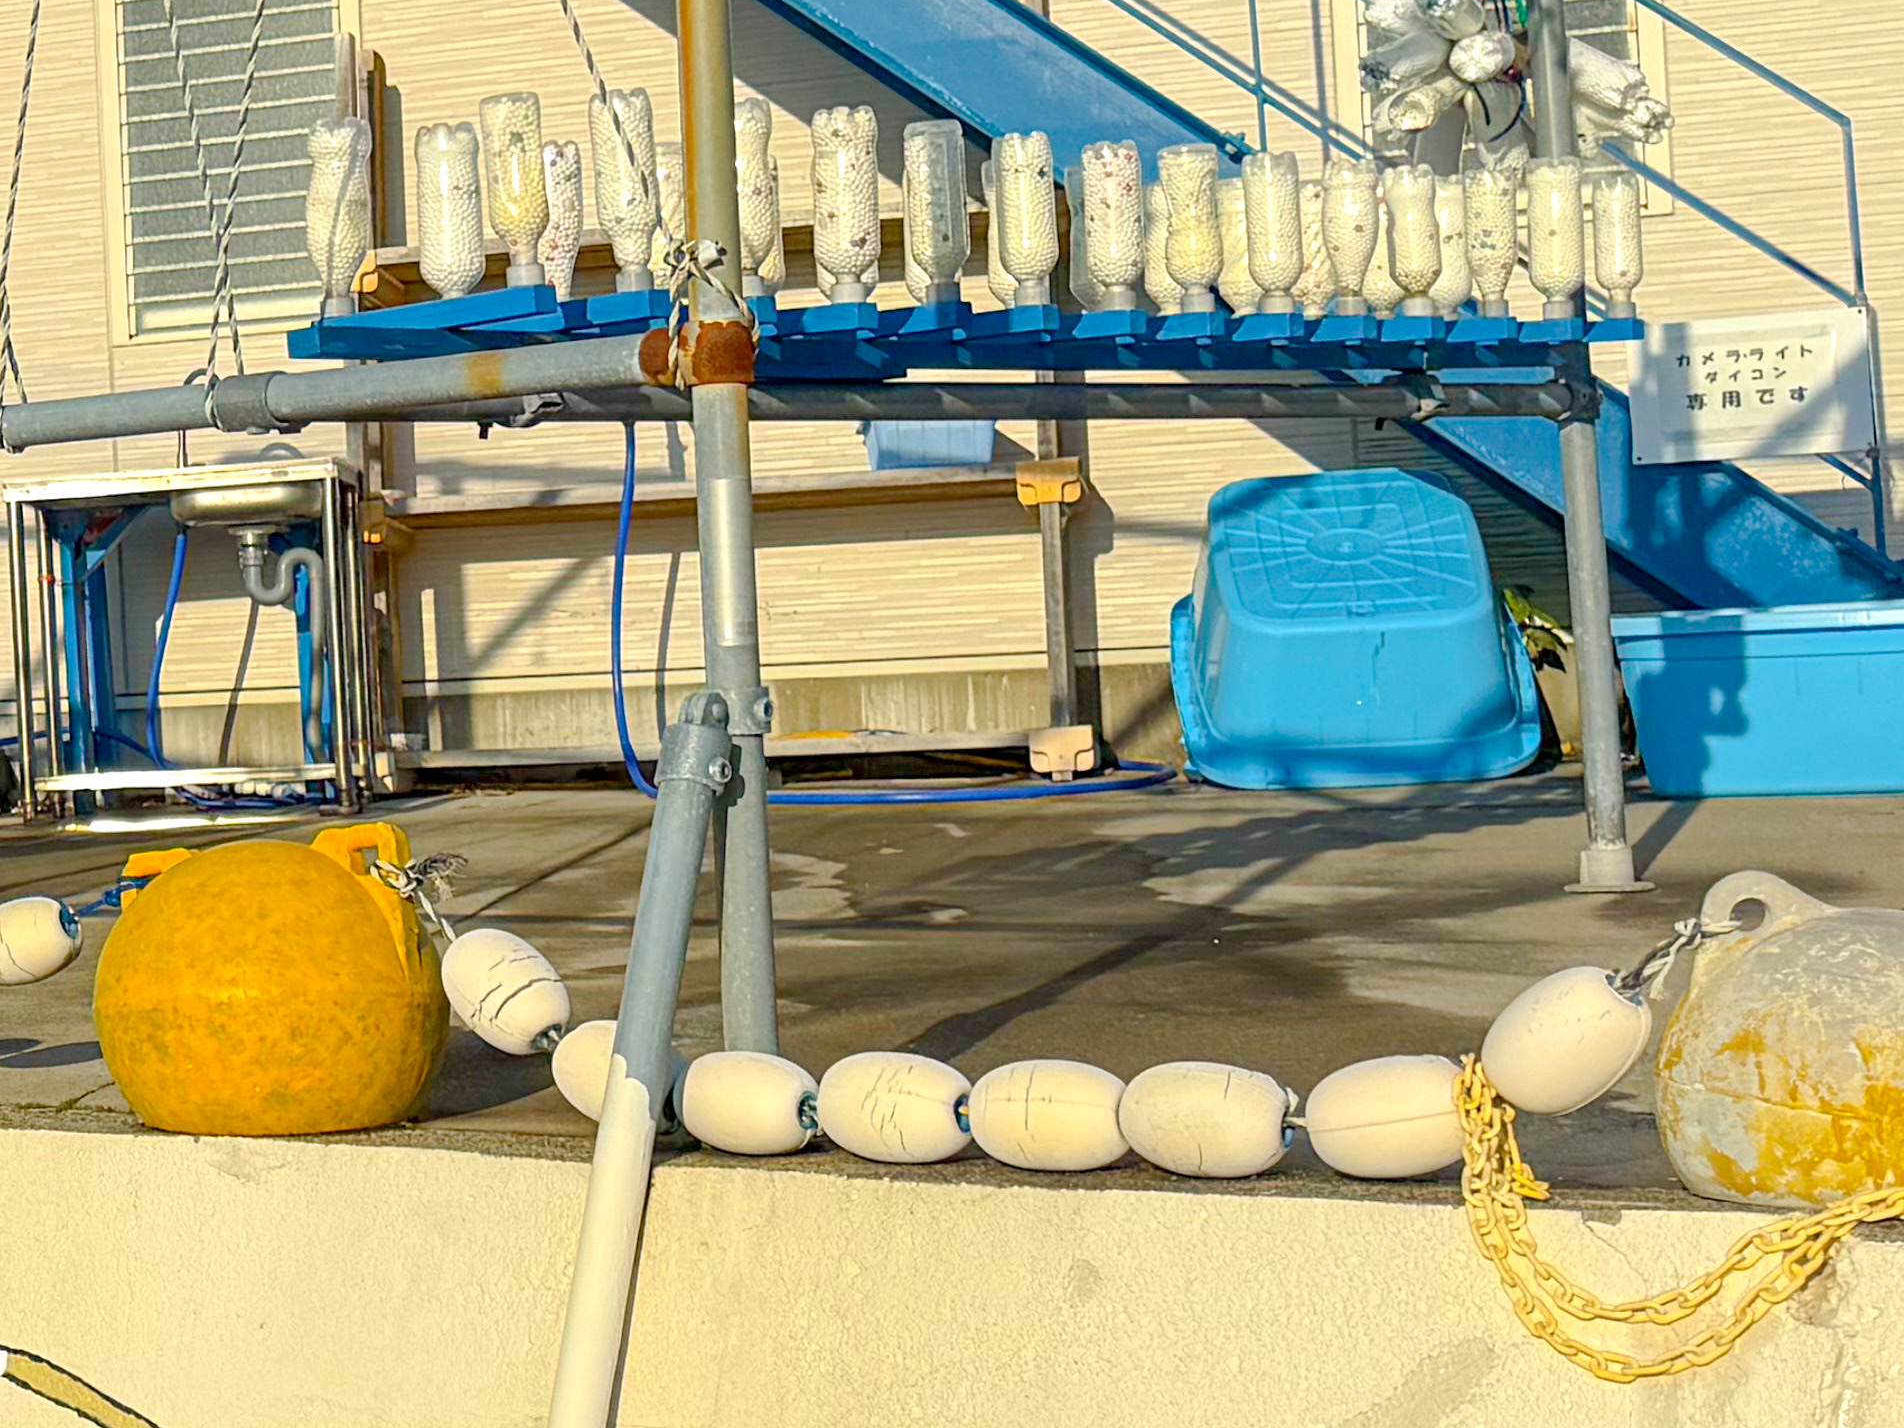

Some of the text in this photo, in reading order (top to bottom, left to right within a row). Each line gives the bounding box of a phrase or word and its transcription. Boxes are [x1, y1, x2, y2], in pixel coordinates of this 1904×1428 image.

[1705, 367, 1787, 383] ダイコン
[1686, 386, 1808, 410] 専用です
